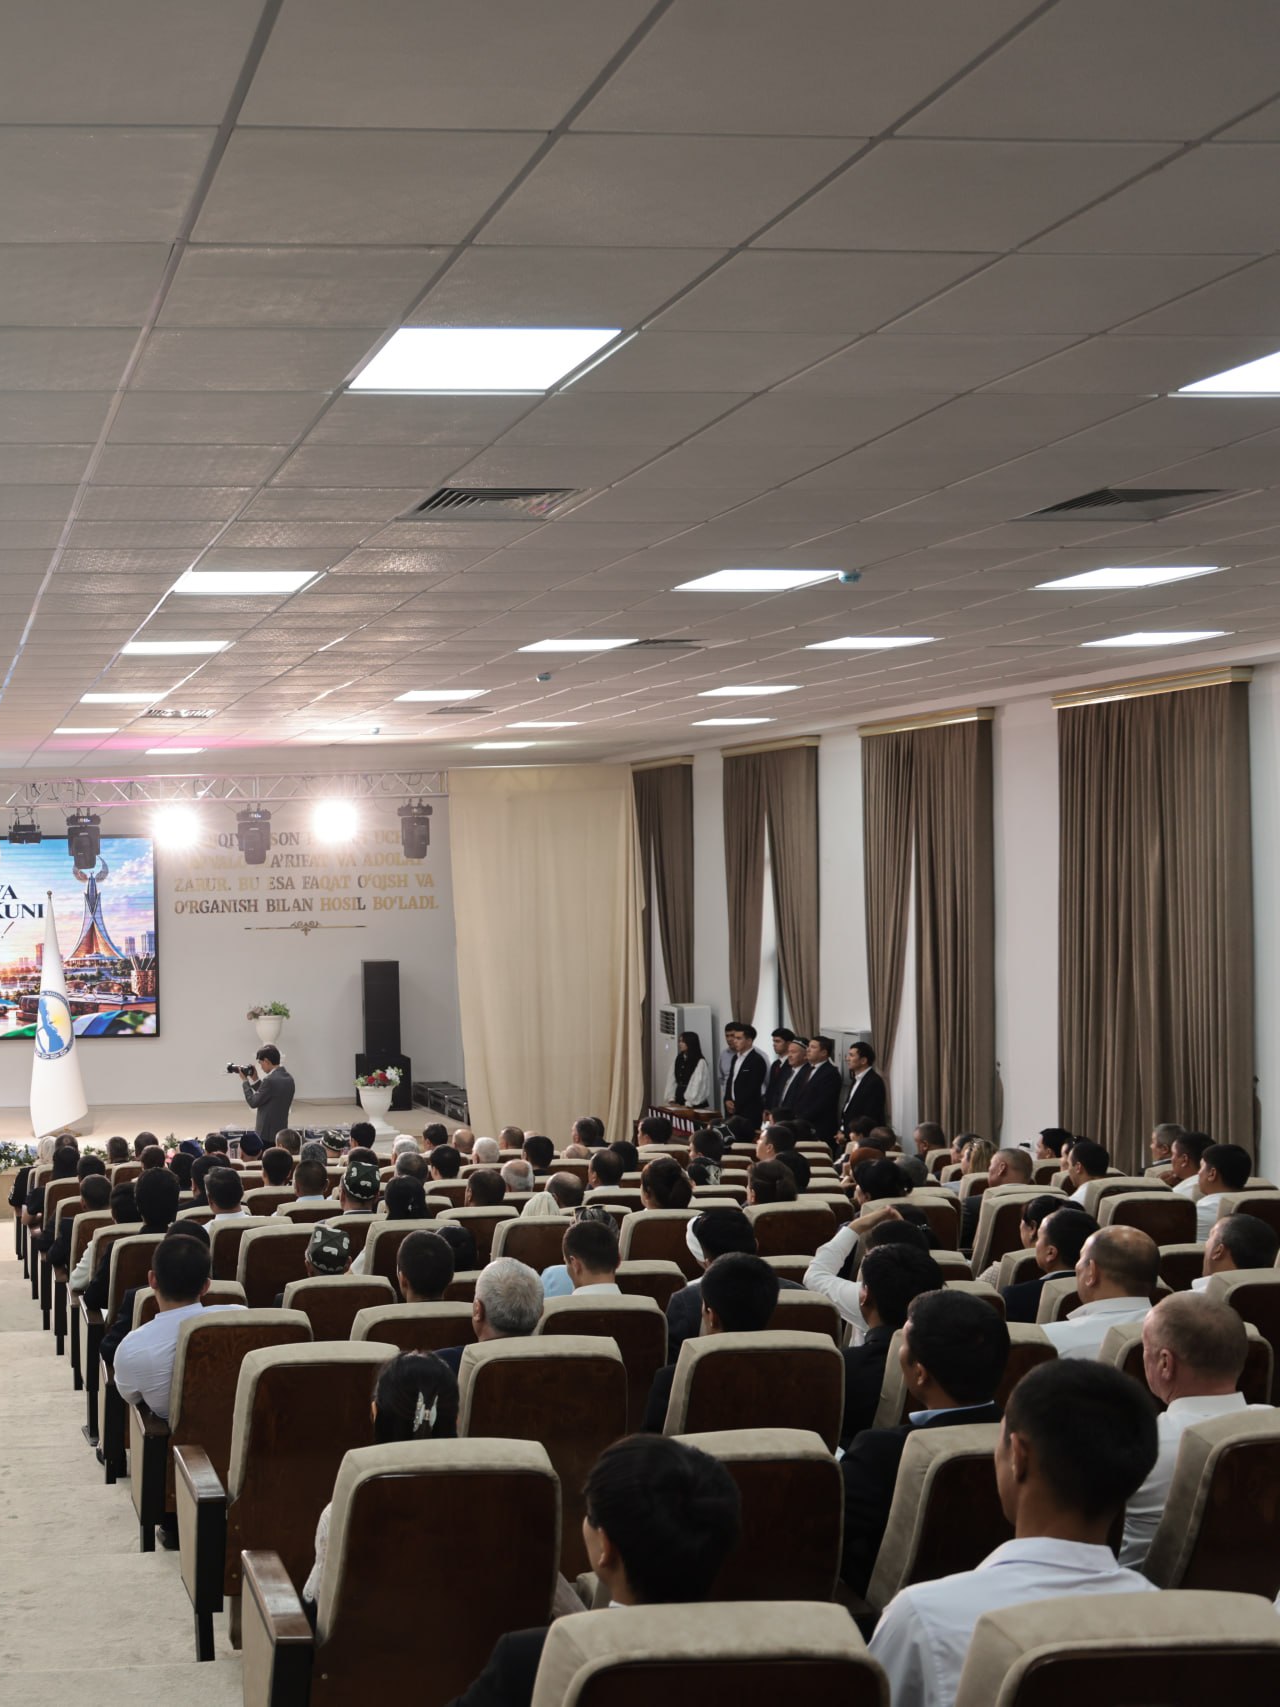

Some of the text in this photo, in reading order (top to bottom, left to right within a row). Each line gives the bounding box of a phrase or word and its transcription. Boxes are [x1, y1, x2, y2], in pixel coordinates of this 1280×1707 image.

[238, 876, 260, 891] BU
[267, 875, 296, 890] ESA
[302, 874, 352, 892] FAQAT
[415, 872, 435, 888] VA
[266, 898, 314, 913] BILAN
[320, 896, 366, 912] HOSIL
